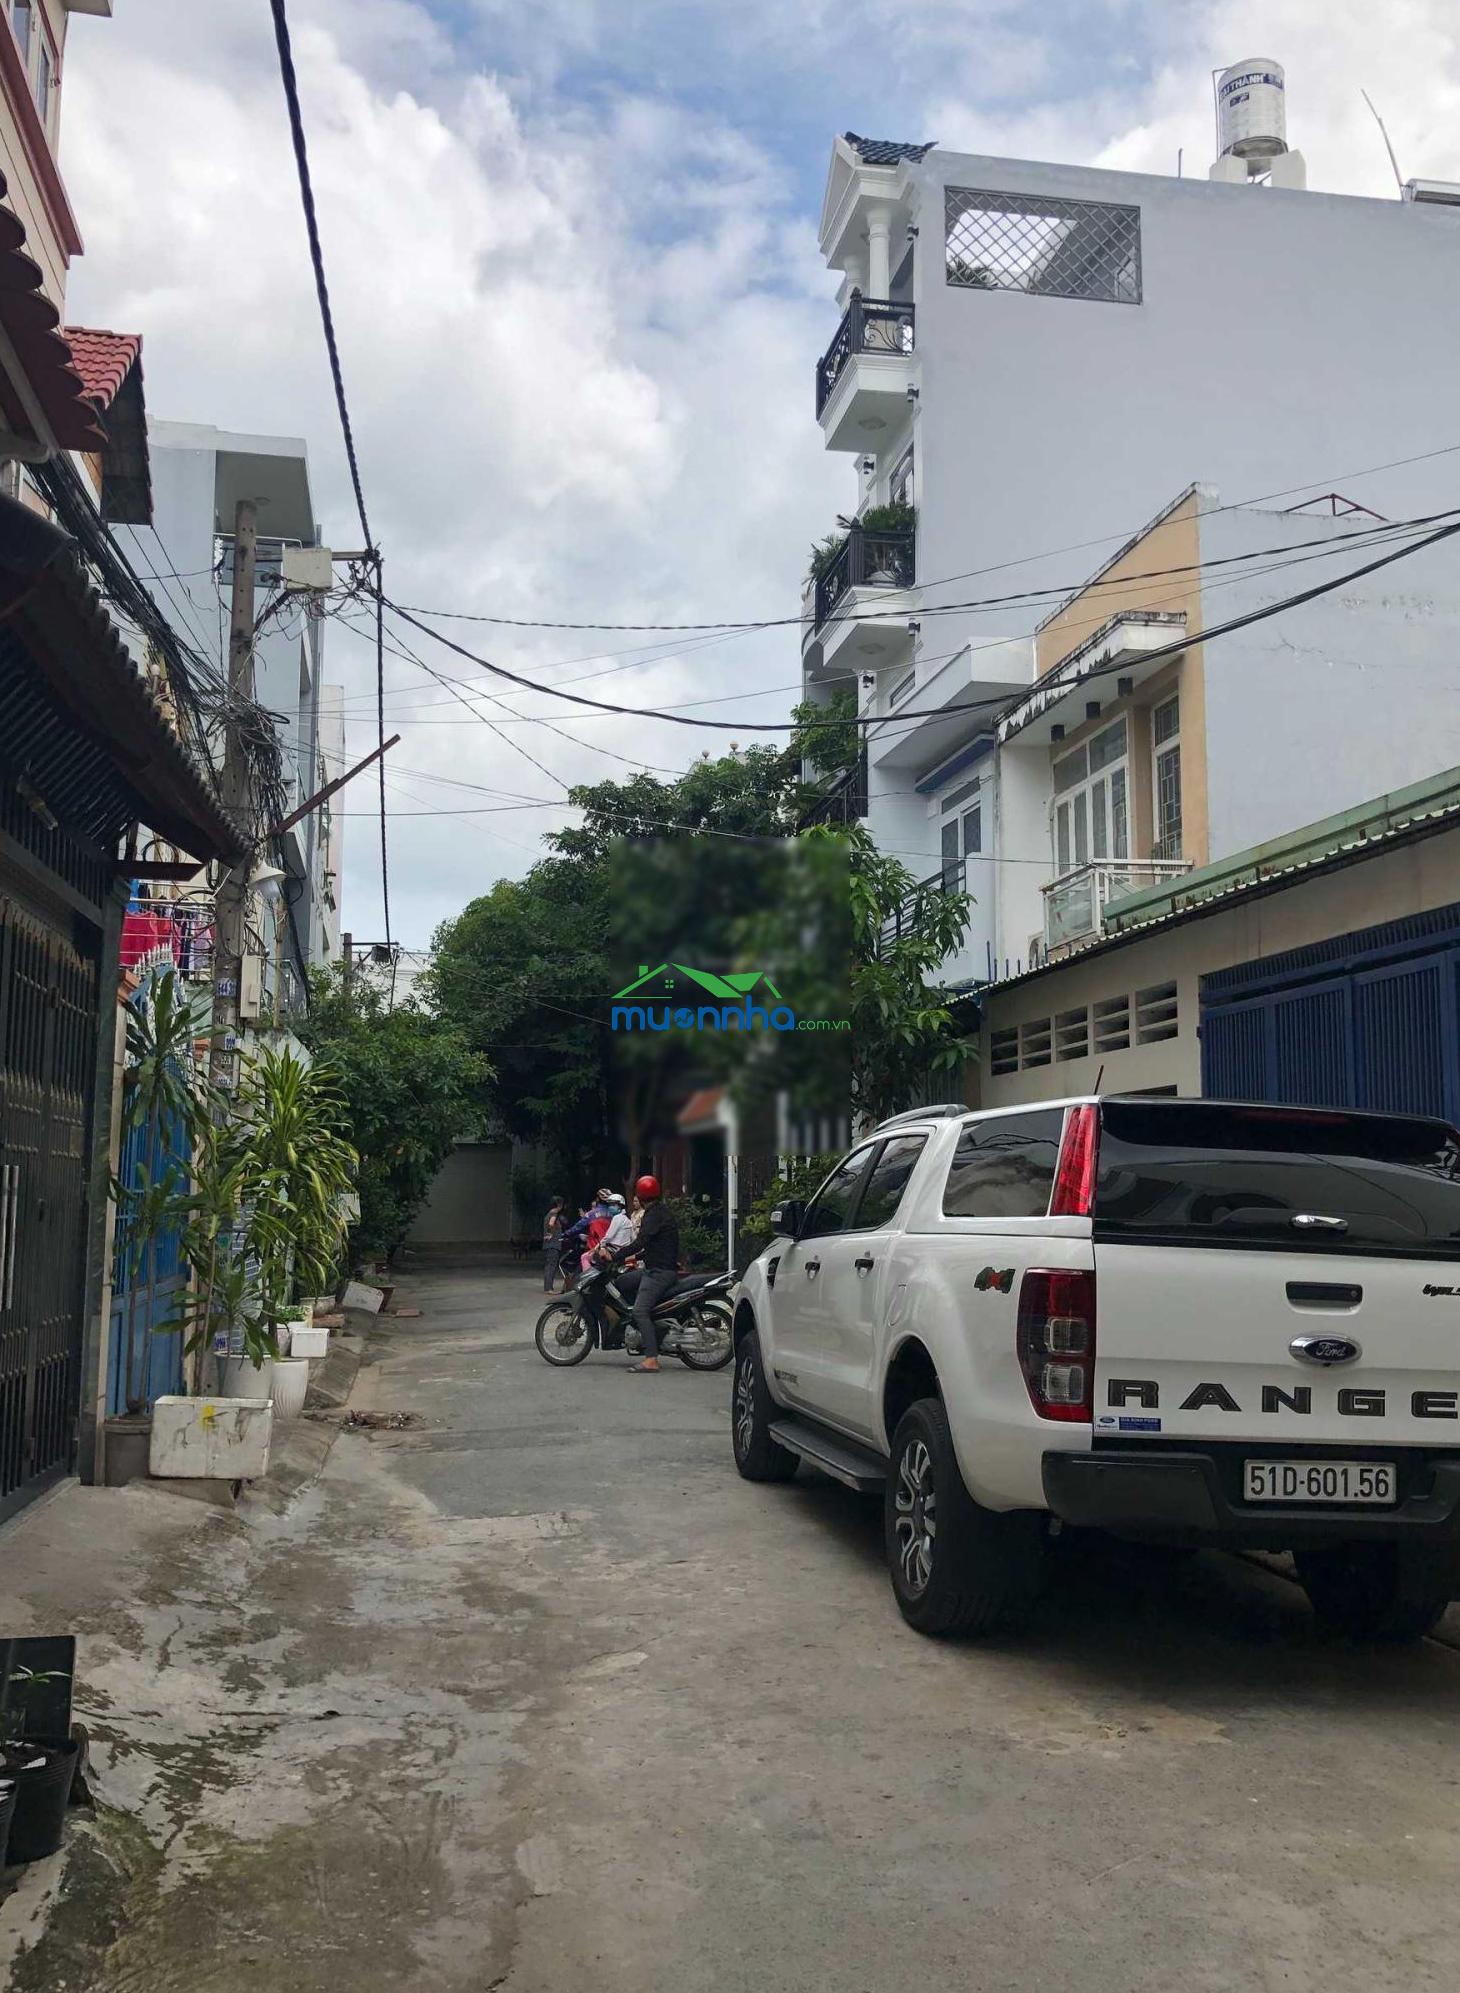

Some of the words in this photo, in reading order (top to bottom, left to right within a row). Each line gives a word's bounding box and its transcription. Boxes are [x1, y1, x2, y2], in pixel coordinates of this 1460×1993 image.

[1316, 1341, 1346, 1357] Ford
[1107, 1378, 1458, 1419] RANGE
[1249, 1465, 1390, 1498] 51D-601.56
